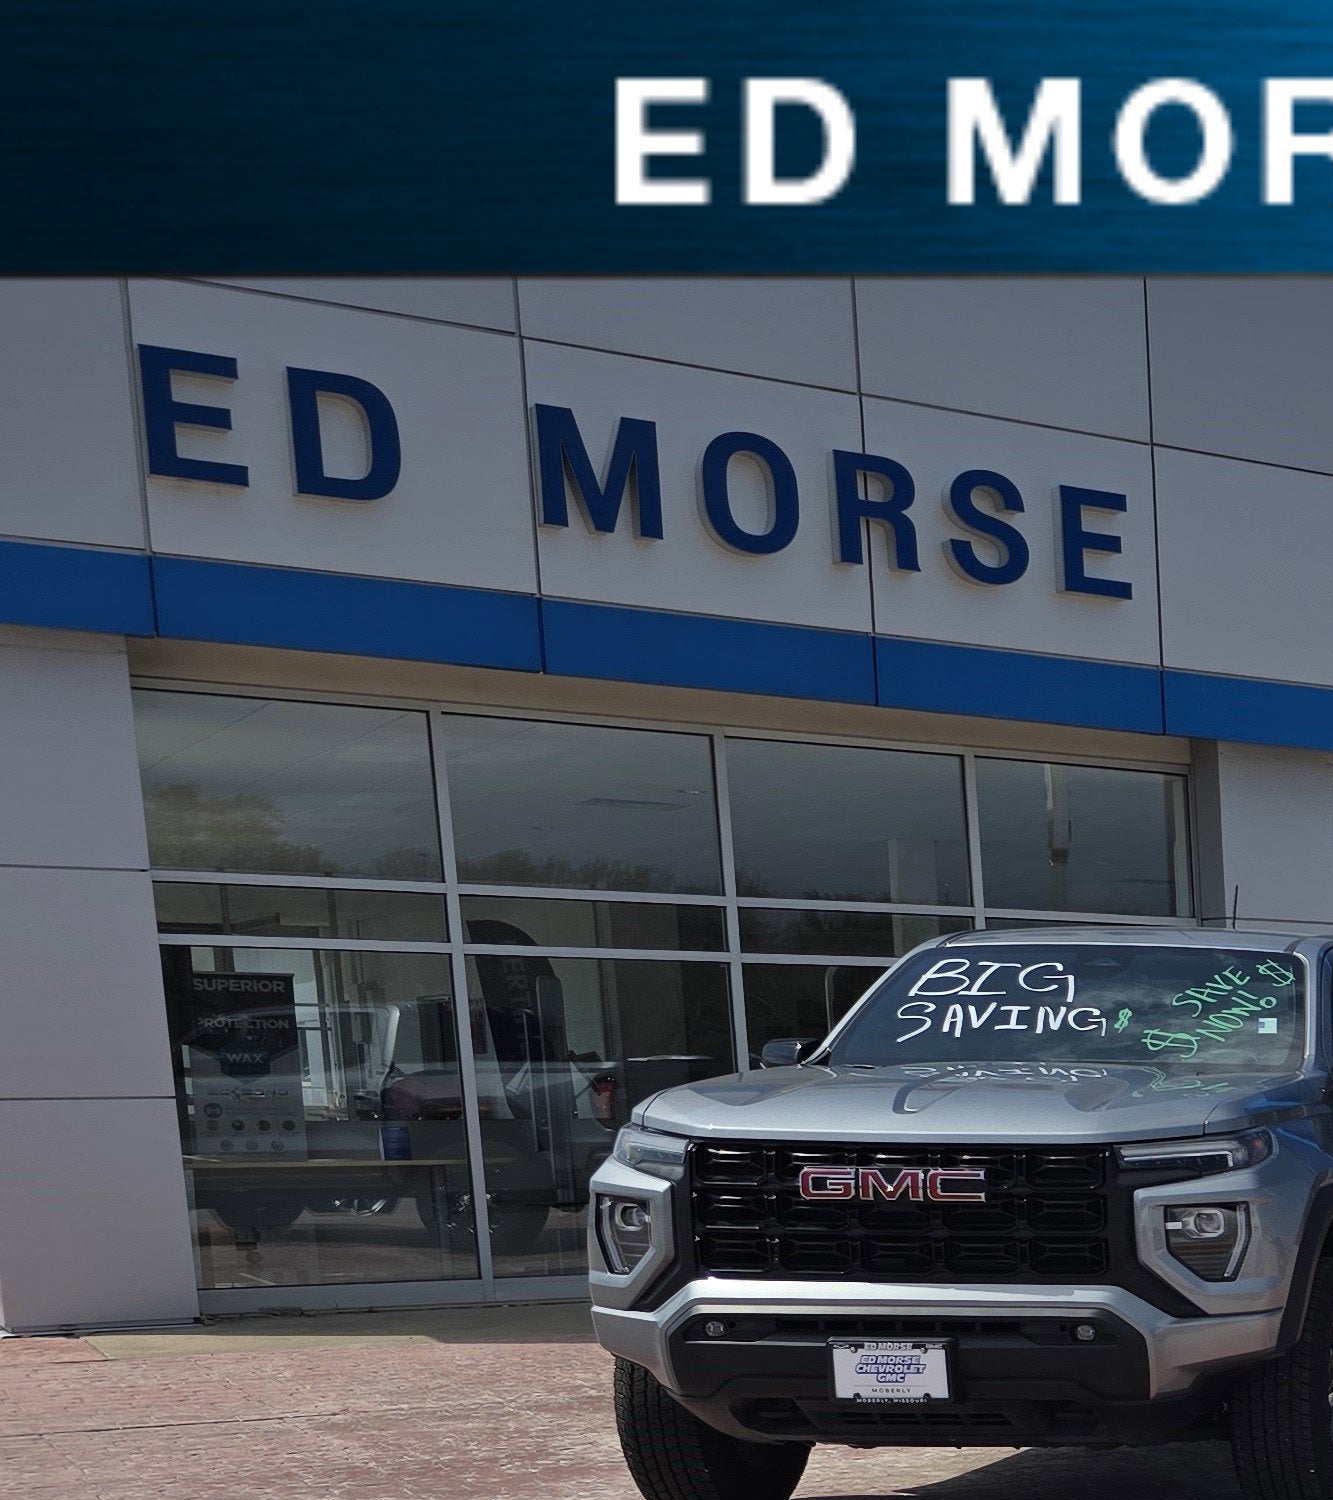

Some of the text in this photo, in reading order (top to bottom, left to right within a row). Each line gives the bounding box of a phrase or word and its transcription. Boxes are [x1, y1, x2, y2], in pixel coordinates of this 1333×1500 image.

[138, 342, 1134, 601] ED MORSE
[193, 978, 286, 994] SUPERIOR
[907, 958, 1075, 1003] BIG
[1171, 965, 1251, 1018] SAVE
[226, 1053, 264, 1065] WAX
[799, 1166, 986, 1202] GMC
[864, 1341, 914, 1351] ED MORSE
[860, 1355, 921, 1364] ED MORSE
[855, 1364, 926, 1374] CHEVROLET
[876, 1373, 905, 1383] GMC
